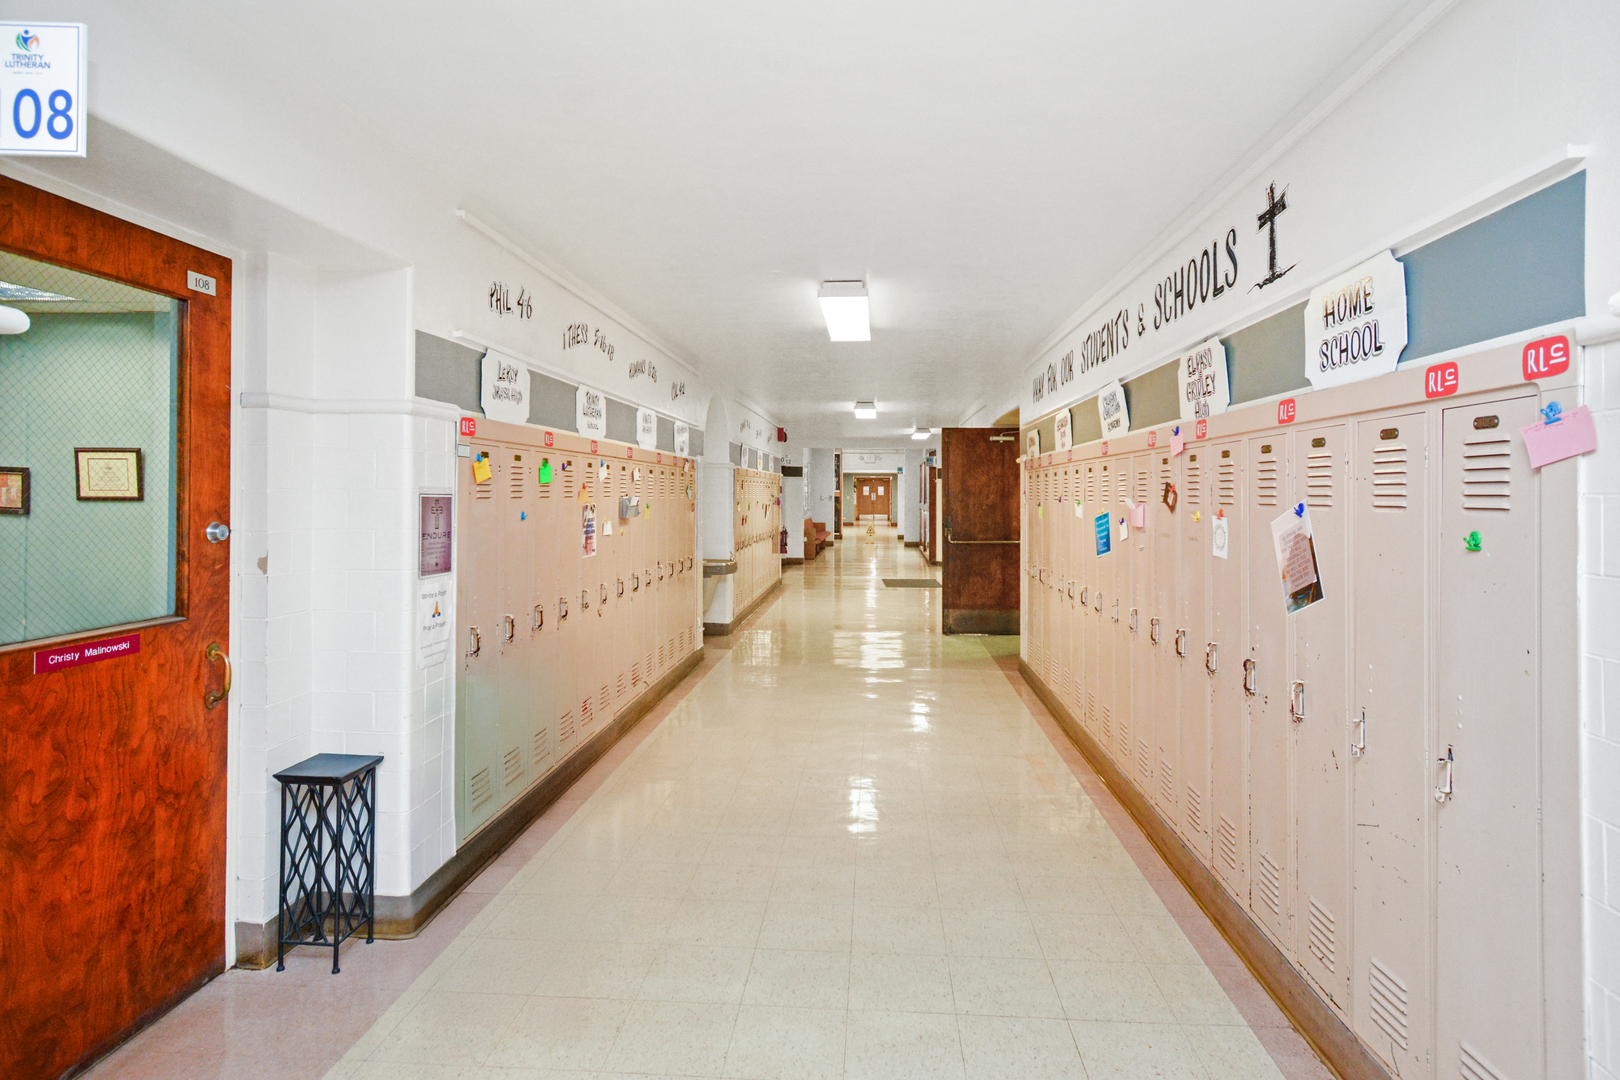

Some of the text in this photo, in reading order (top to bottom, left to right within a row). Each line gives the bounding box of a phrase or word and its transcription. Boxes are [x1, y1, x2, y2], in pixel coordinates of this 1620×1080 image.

[5, 60, 51, 69] LUTHERAN
[11, 53, 44, 61] TRINITY
[0, 88, 73, 140] 08
[195, 277, 210, 290] 108
[517, 287, 532, 319] 4:6
[1047, 362, 1057, 394] FOR
[1061, 350, 1073, 385] OUR
[1081, 309, 1129, 374] STUDENTS
[1137, 303, 1145, 336] &
[1153, 228, 1237, 330] SCHOOLS
[1323, 276, 1374, 328] HOME
[1320, 322, 1384, 370] SCHOOL
[1187, 371, 1216, 402] GRIDLEY
[421, 531, 451, 540] ENDURE
[48, 641, 130, 664] Christy Malinowski
